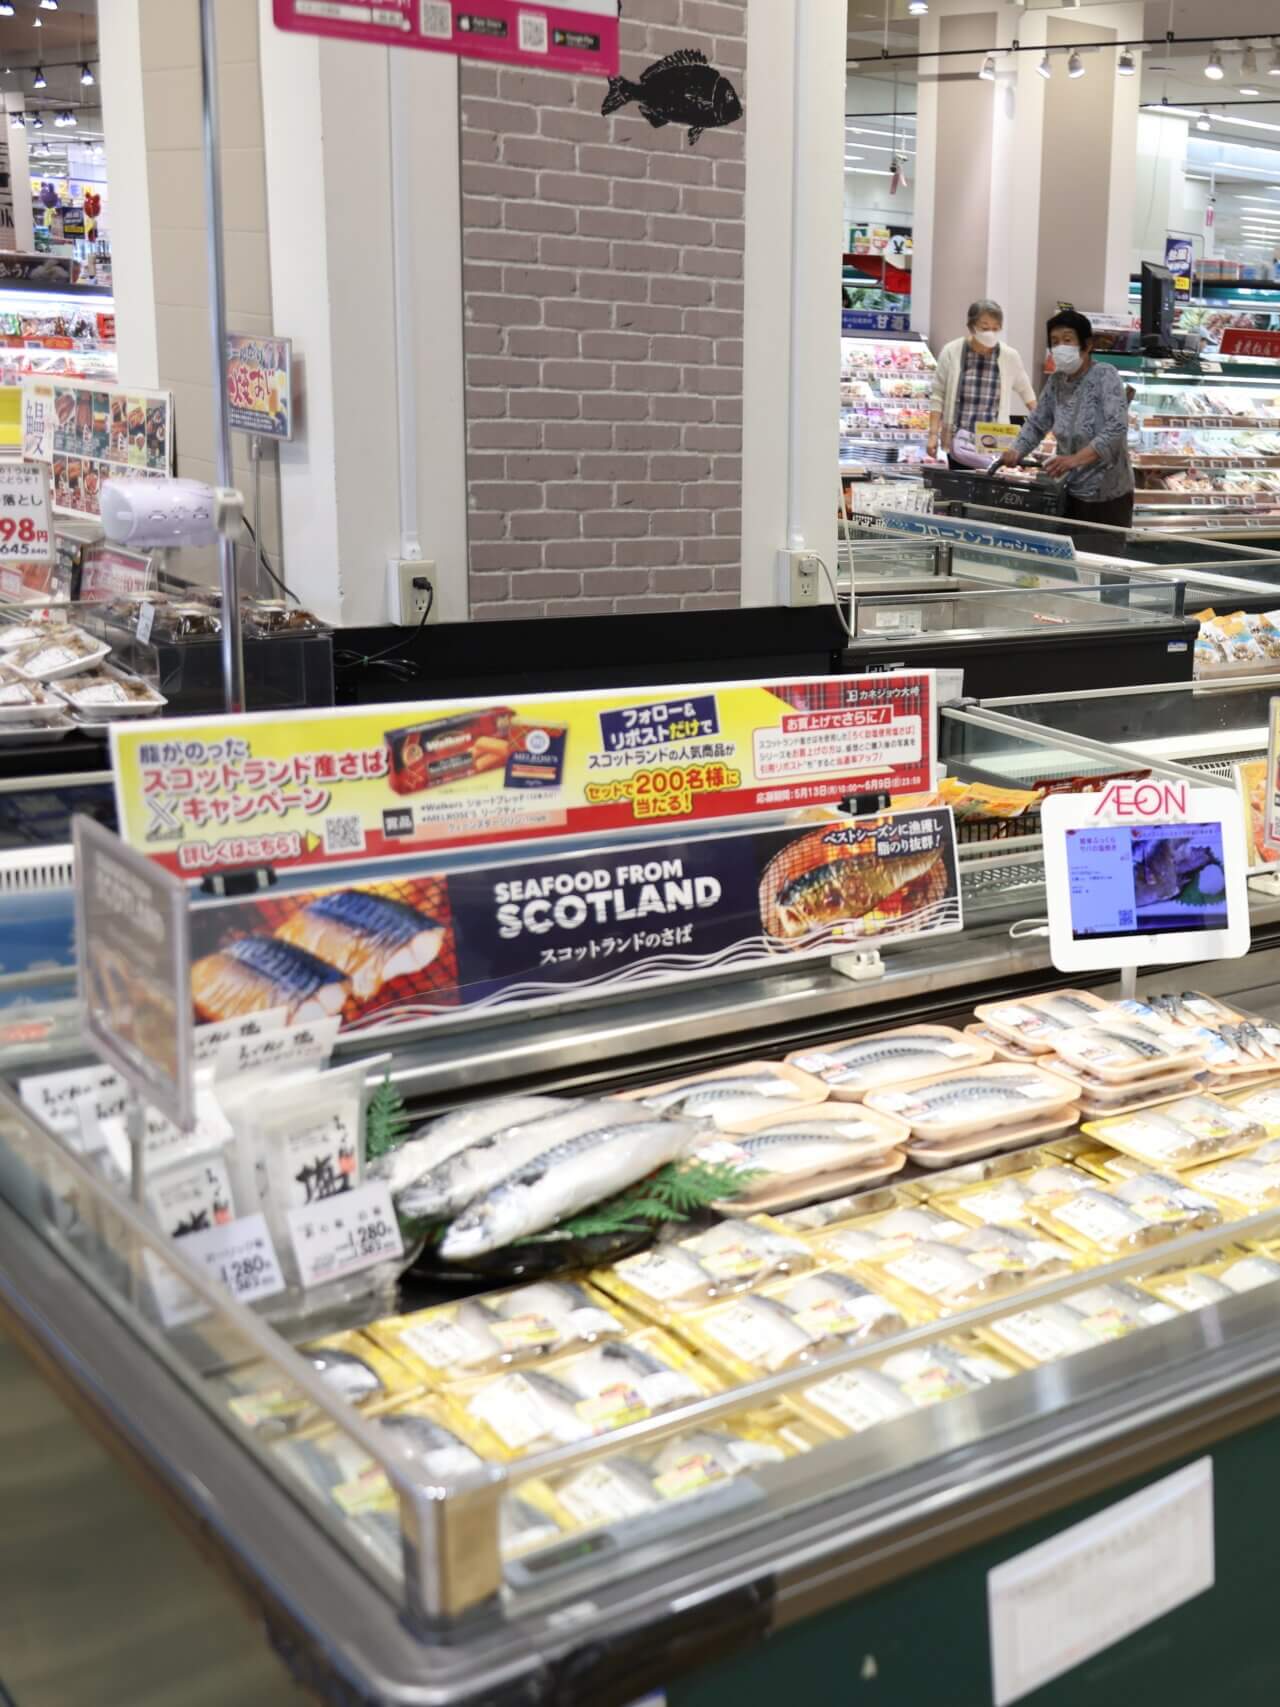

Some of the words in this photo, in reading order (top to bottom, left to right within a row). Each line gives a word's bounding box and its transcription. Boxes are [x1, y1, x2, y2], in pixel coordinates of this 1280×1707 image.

[494, 869, 611, 903] SEAFOOD
[616, 858, 684, 886] FROM
[496, 876, 722, 939] SCOTLAND
